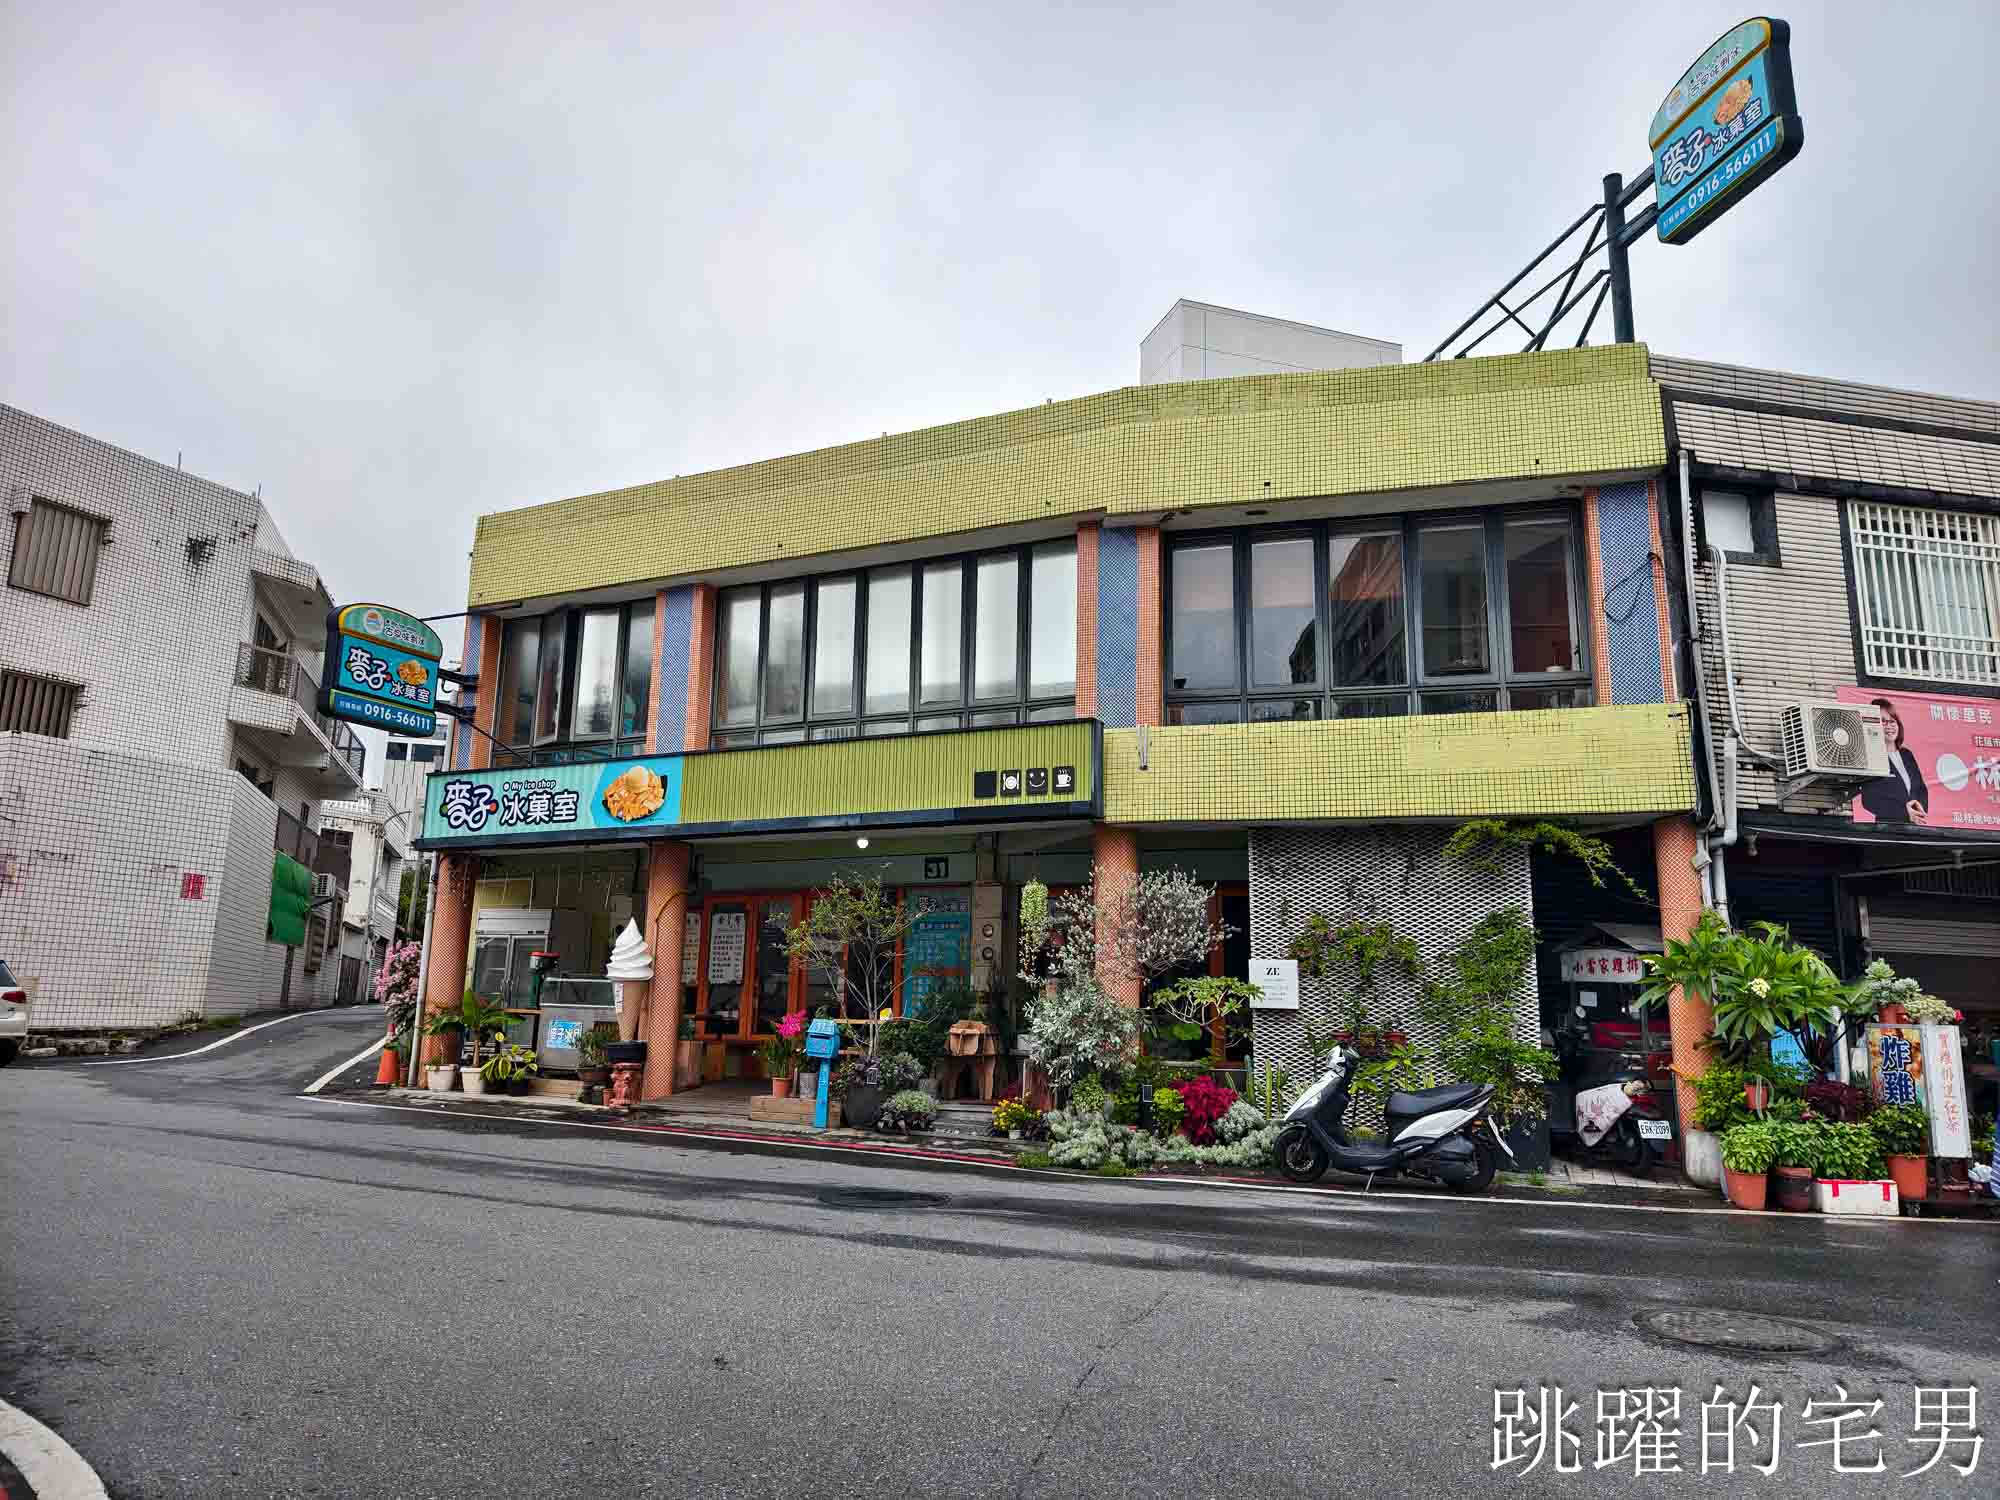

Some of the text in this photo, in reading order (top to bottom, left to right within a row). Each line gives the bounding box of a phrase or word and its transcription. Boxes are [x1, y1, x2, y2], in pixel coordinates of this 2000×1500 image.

[1662, 128, 1706, 185] 麥子
[1688, 132, 1771, 209] 0916-566111
[347, 647, 388, 690] 麥子
[391, 680, 430, 704] 冰菓室
[364, 703, 431, 731] 0916-566111
[511, 779, 556, 792] My ice shop
[445, 782, 494, 830] 麥子
[502, 792, 578, 825] 冰菓室
[1265, 967, 1280, 976] ZE
[1880, 1034, 1915, 1105] 炸雞
